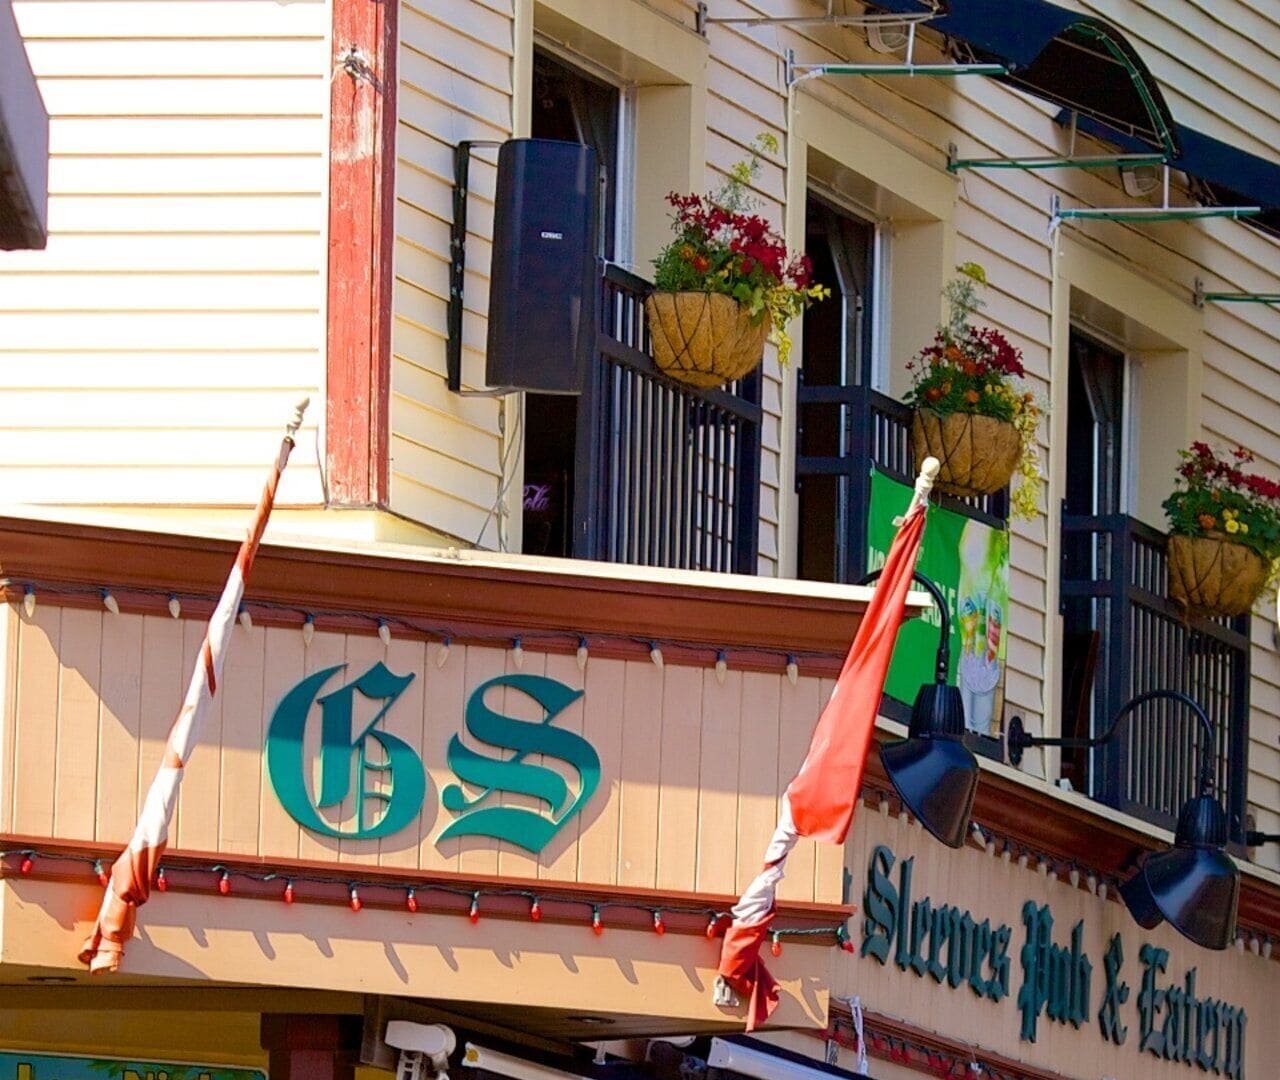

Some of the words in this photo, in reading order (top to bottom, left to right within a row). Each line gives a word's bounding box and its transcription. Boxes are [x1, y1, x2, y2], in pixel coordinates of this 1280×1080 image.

[862, 845, 1012, 1002] Sleeves
[1018, 900, 1092, 1043] Pub
[1099, 932, 1130, 1046] &
